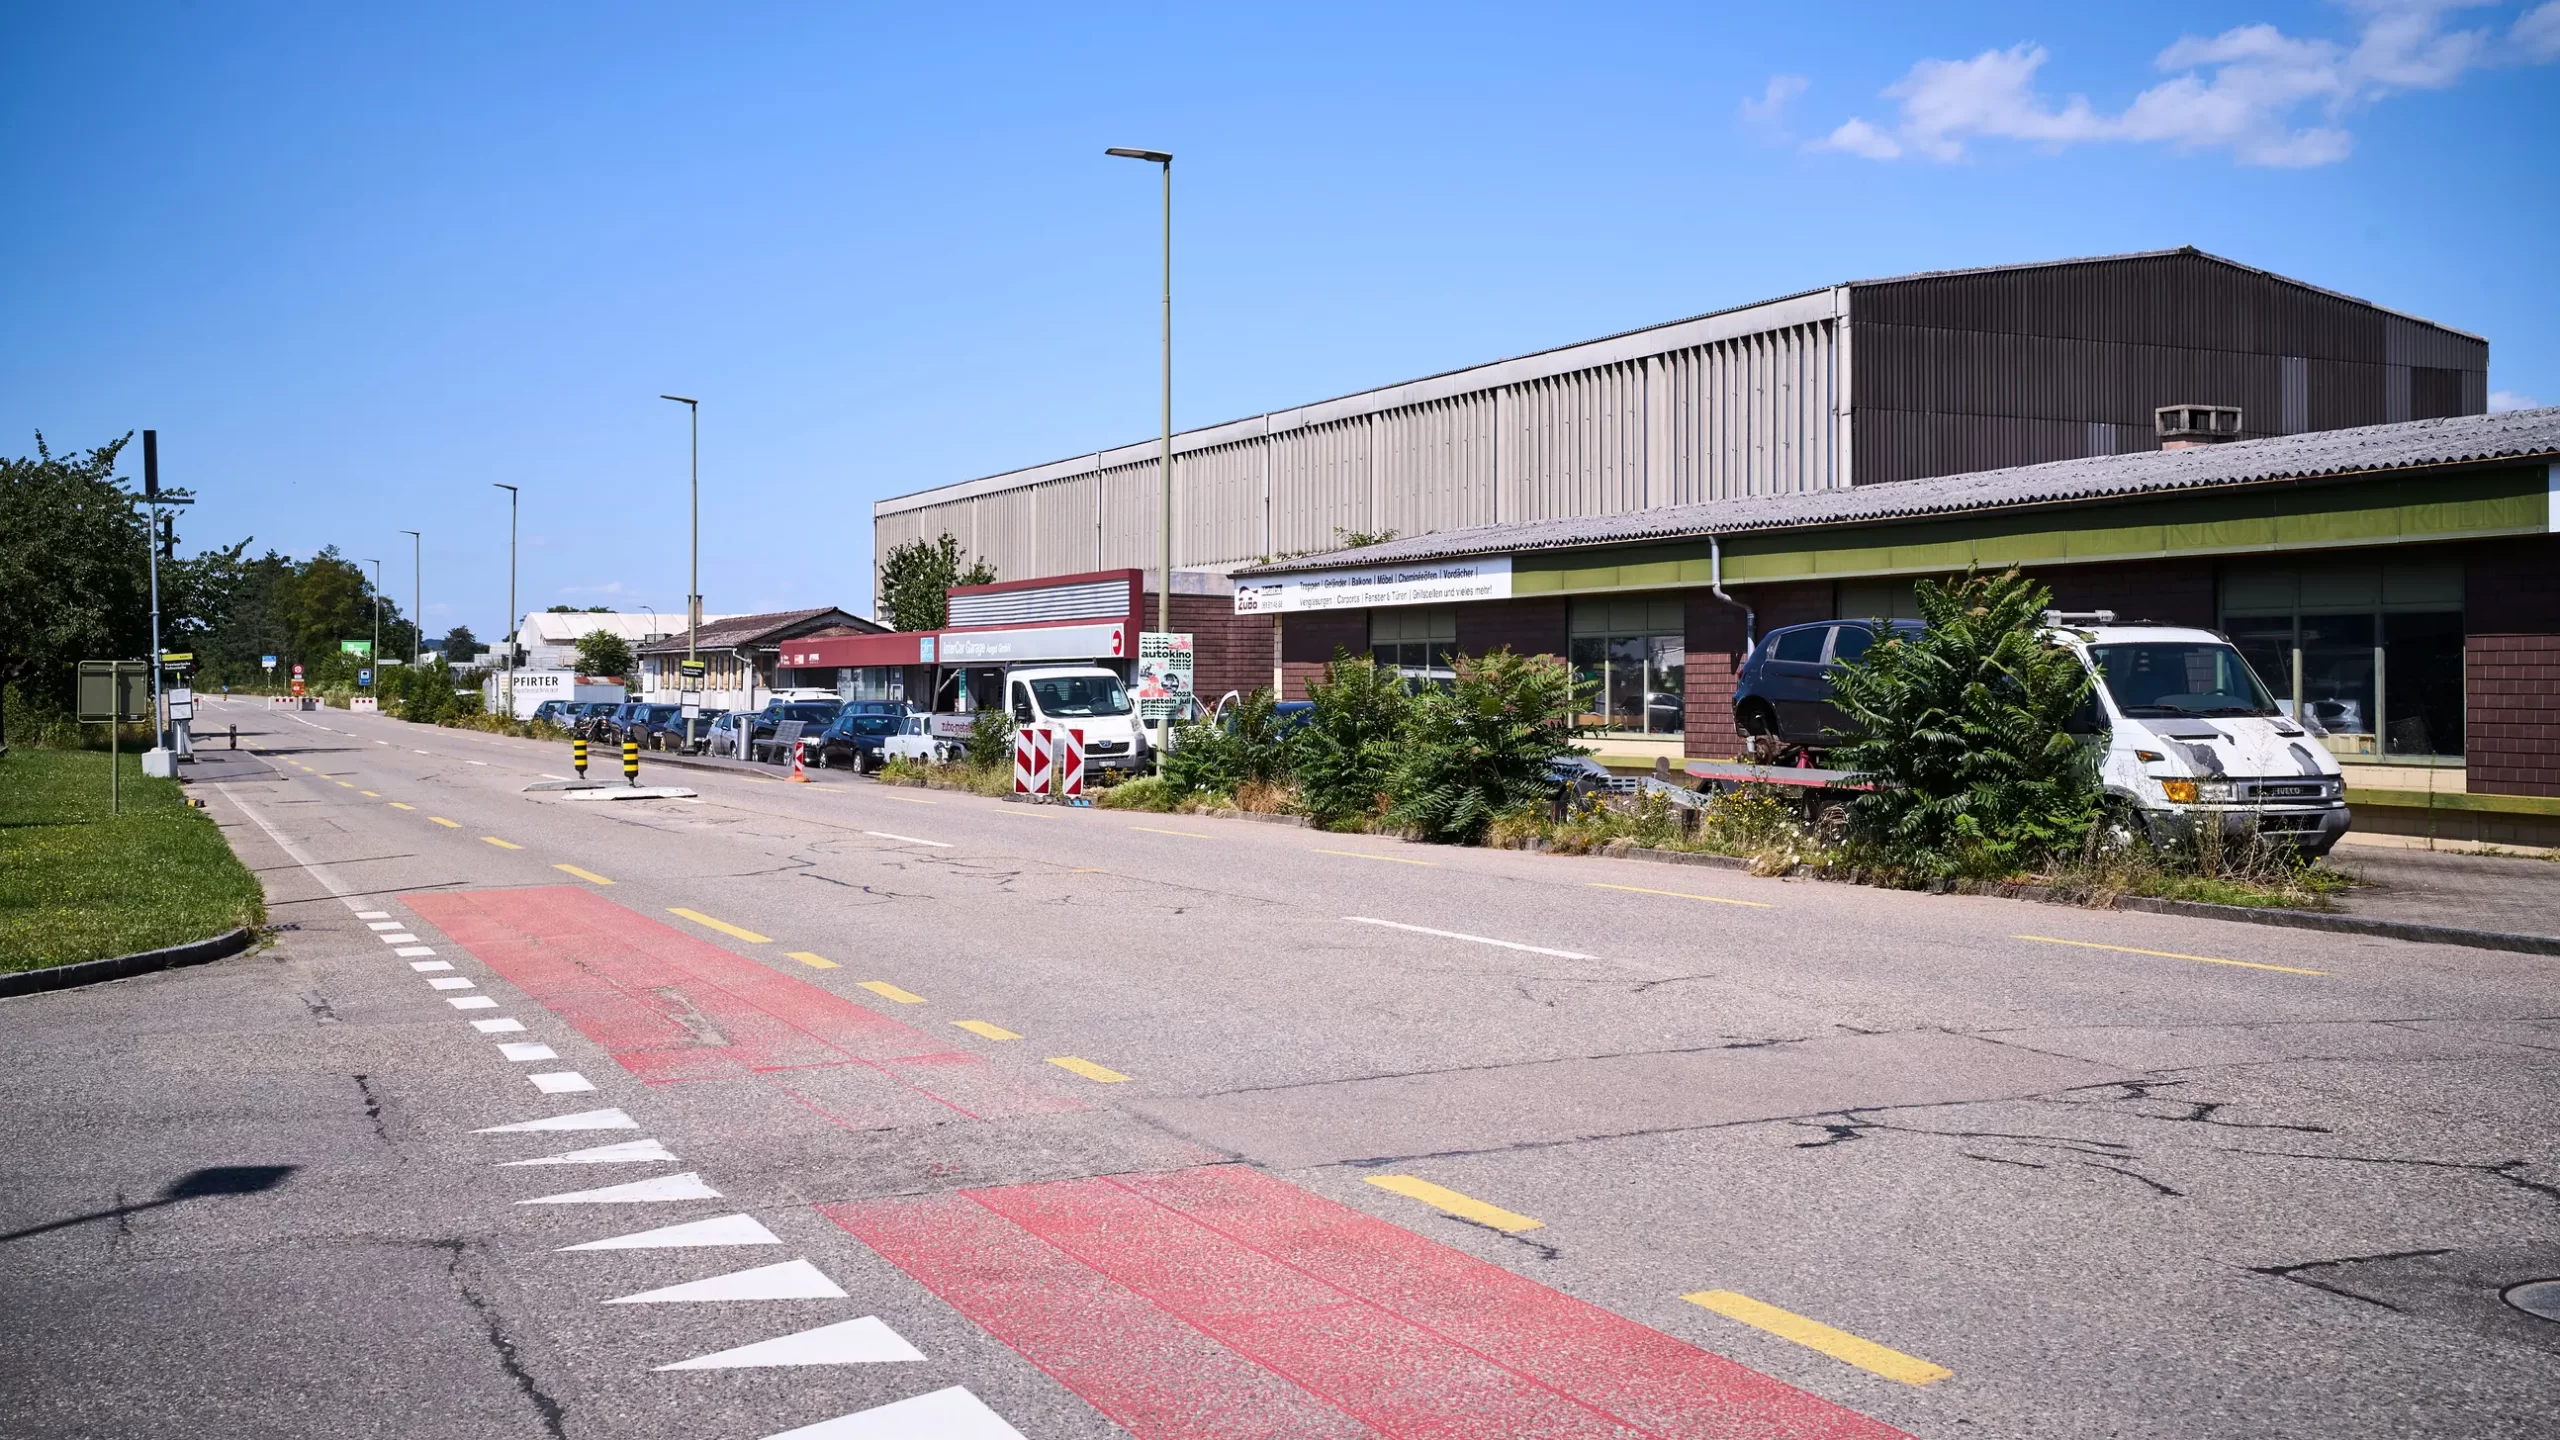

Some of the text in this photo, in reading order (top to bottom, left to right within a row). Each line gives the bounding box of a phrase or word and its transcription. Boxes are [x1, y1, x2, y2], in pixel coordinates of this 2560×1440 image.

[1299, 580, 1320, 592] Treppen
[1324, 578, 1347, 588] Geländer
[1351, 576, 1373, 587] Balkone
[1377, 574, 1394, 585] Möbel
[1443, 567, 1474, 579] Vordächer
[1336, 594, 1360, 606] Carports
[1364, 592, 1386, 603] Fenster
[1392, 590, 1408, 601] Türen
[1412, 587, 1443, 600] Grillstellen
[1443, 587, 1455, 598] und
[1456, 585, 1474, 597] vieles
[1475, 584, 1493, 595] mehr!
[943, 640, 965, 655] InterCar
[965, 639, 985, 657] Garage
[998, 642, 1012, 653] GmbH
[1141, 649, 1192, 659] autokino
[513, 676, 559, 686] PFIRTER
[1141, 697, 1191, 706] pratteln juli
[2276, 787, 2300, 795] IVECO
